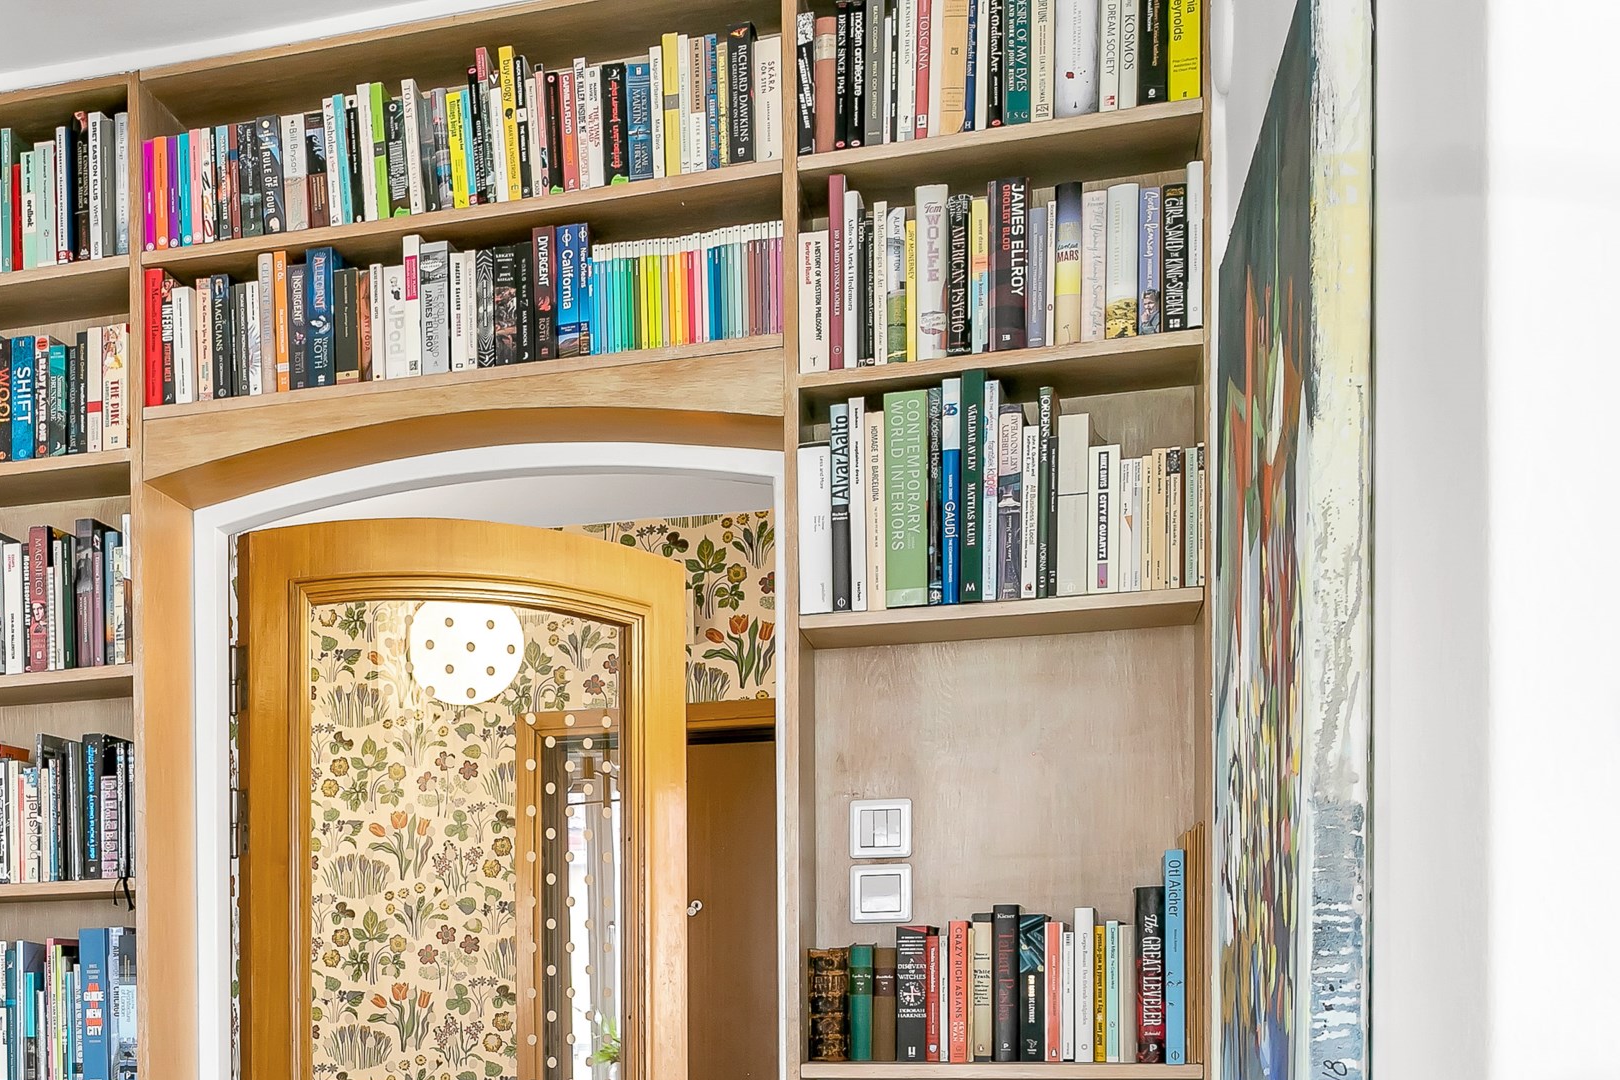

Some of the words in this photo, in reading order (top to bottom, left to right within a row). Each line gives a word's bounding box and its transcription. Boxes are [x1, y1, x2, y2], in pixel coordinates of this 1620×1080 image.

[854, 12, 863, 46] modern
[1107, 4, 1116, 37] DREAM
[919, 15, 929, 70] TOSCANA
[1105, 39, 1116, 75] SOCIETY
[1124, 14, 1135, 70] KOSMOS
[737, 44, 747, 92] RICHARD
[838, 49, 846, 74] SINCE
[854, 48, 863, 96] architecture
[404, 86, 412, 119] TOAST
[837, 76, 845, 94] 1945
[289, 128, 297, 141] Bill
[326, 114, 334, 154] Assholes
[739, 95, 748, 142] DAWKINS
[262, 152, 272, 174] RULE
[289, 144, 298, 173] Bryson
[265, 177, 272, 188] OF
[266, 191, 275, 214] FOUR
[1011, 183, 1024, 235] JAMES
[538, 236, 549, 286] DIVERGENT
[952, 225, 964, 284] AMERICAN
[1011, 240, 1024, 296] ELLROY
[313, 257, 325, 308] ALLEGIANT
[562, 250, 573, 309] California
[292, 276, 303, 321] INSURGENT
[952, 289, 964, 333] PSYCHO
[162, 304, 172, 342] INFERNO
[214, 299, 224, 351] MAGICIANS
[425, 321, 433, 353] ELLROY
[314, 338, 323, 369] ROTH
[17, 367, 31, 424] SHIFT
[39, 423, 47, 442] ONE
[890, 400, 903, 458] WORLD
[906, 399, 920, 535] CONTEMPORARY
[1099, 453, 1108, 469] MIKE
[1099, 470, 1108, 488] DAVIS
[891, 465, 904, 551] INTERIORS
[944, 501, 958, 538] GAUDÍ
[967, 483, 976, 520] MATTIAS
[1099, 495, 1107, 514] CITY
[967, 522, 976, 546] KLUM
[1099, 524, 1107, 558] QUARTZ
[35, 538, 43, 595] MAGNIFICO
[26, 795, 38, 859] bookshelf
[1168, 859, 1181, 877] Otl
[1168, 880, 1181, 917] Aicher
[1144, 914, 1158, 934] The
[955, 961, 963, 982] RICH
[1142, 936, 1161, 974] GREAT
[955, 986, 963, 1018] ASIANS
[1142, 976, 1162, 1026] LEVELER
